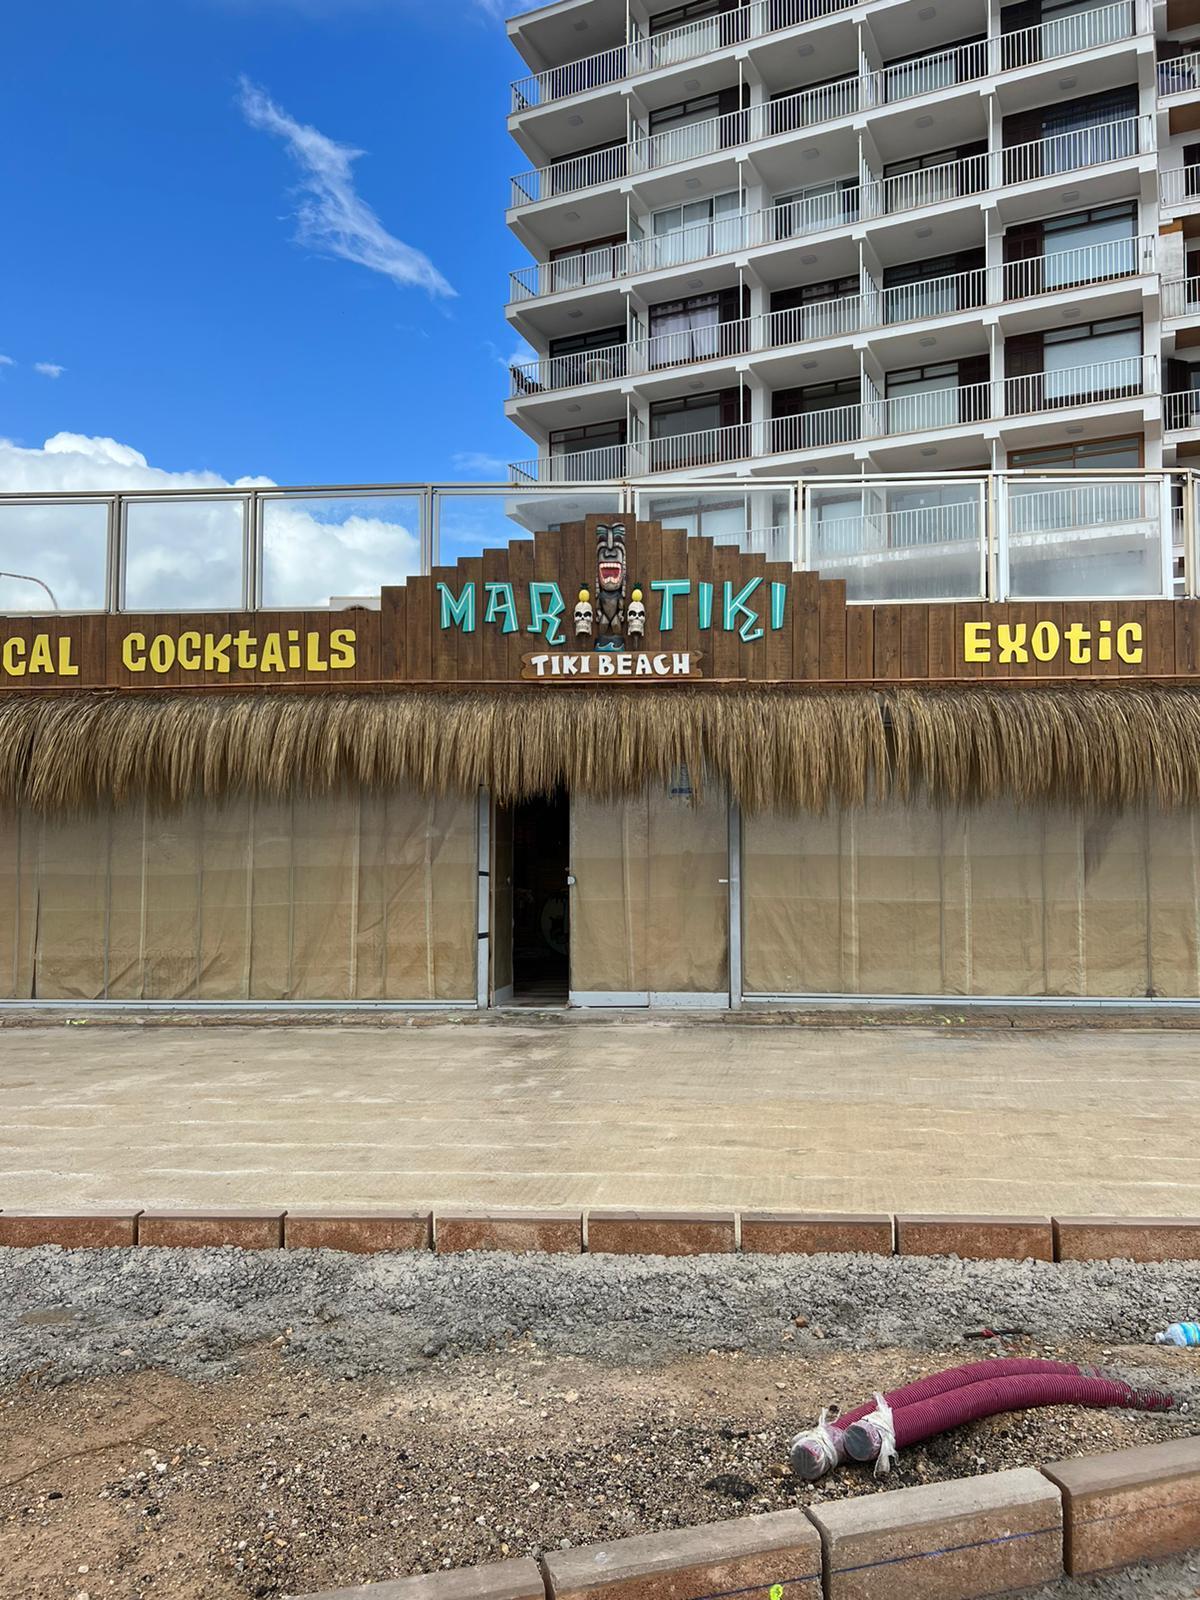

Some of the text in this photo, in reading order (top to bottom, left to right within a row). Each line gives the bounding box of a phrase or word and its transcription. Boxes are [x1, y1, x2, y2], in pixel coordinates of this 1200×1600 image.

[436, 577, 787, 645] MAR TIKI
[2, 634, 79, 676] CAL
[530, 653, 691, 677] TIKI BEACH
